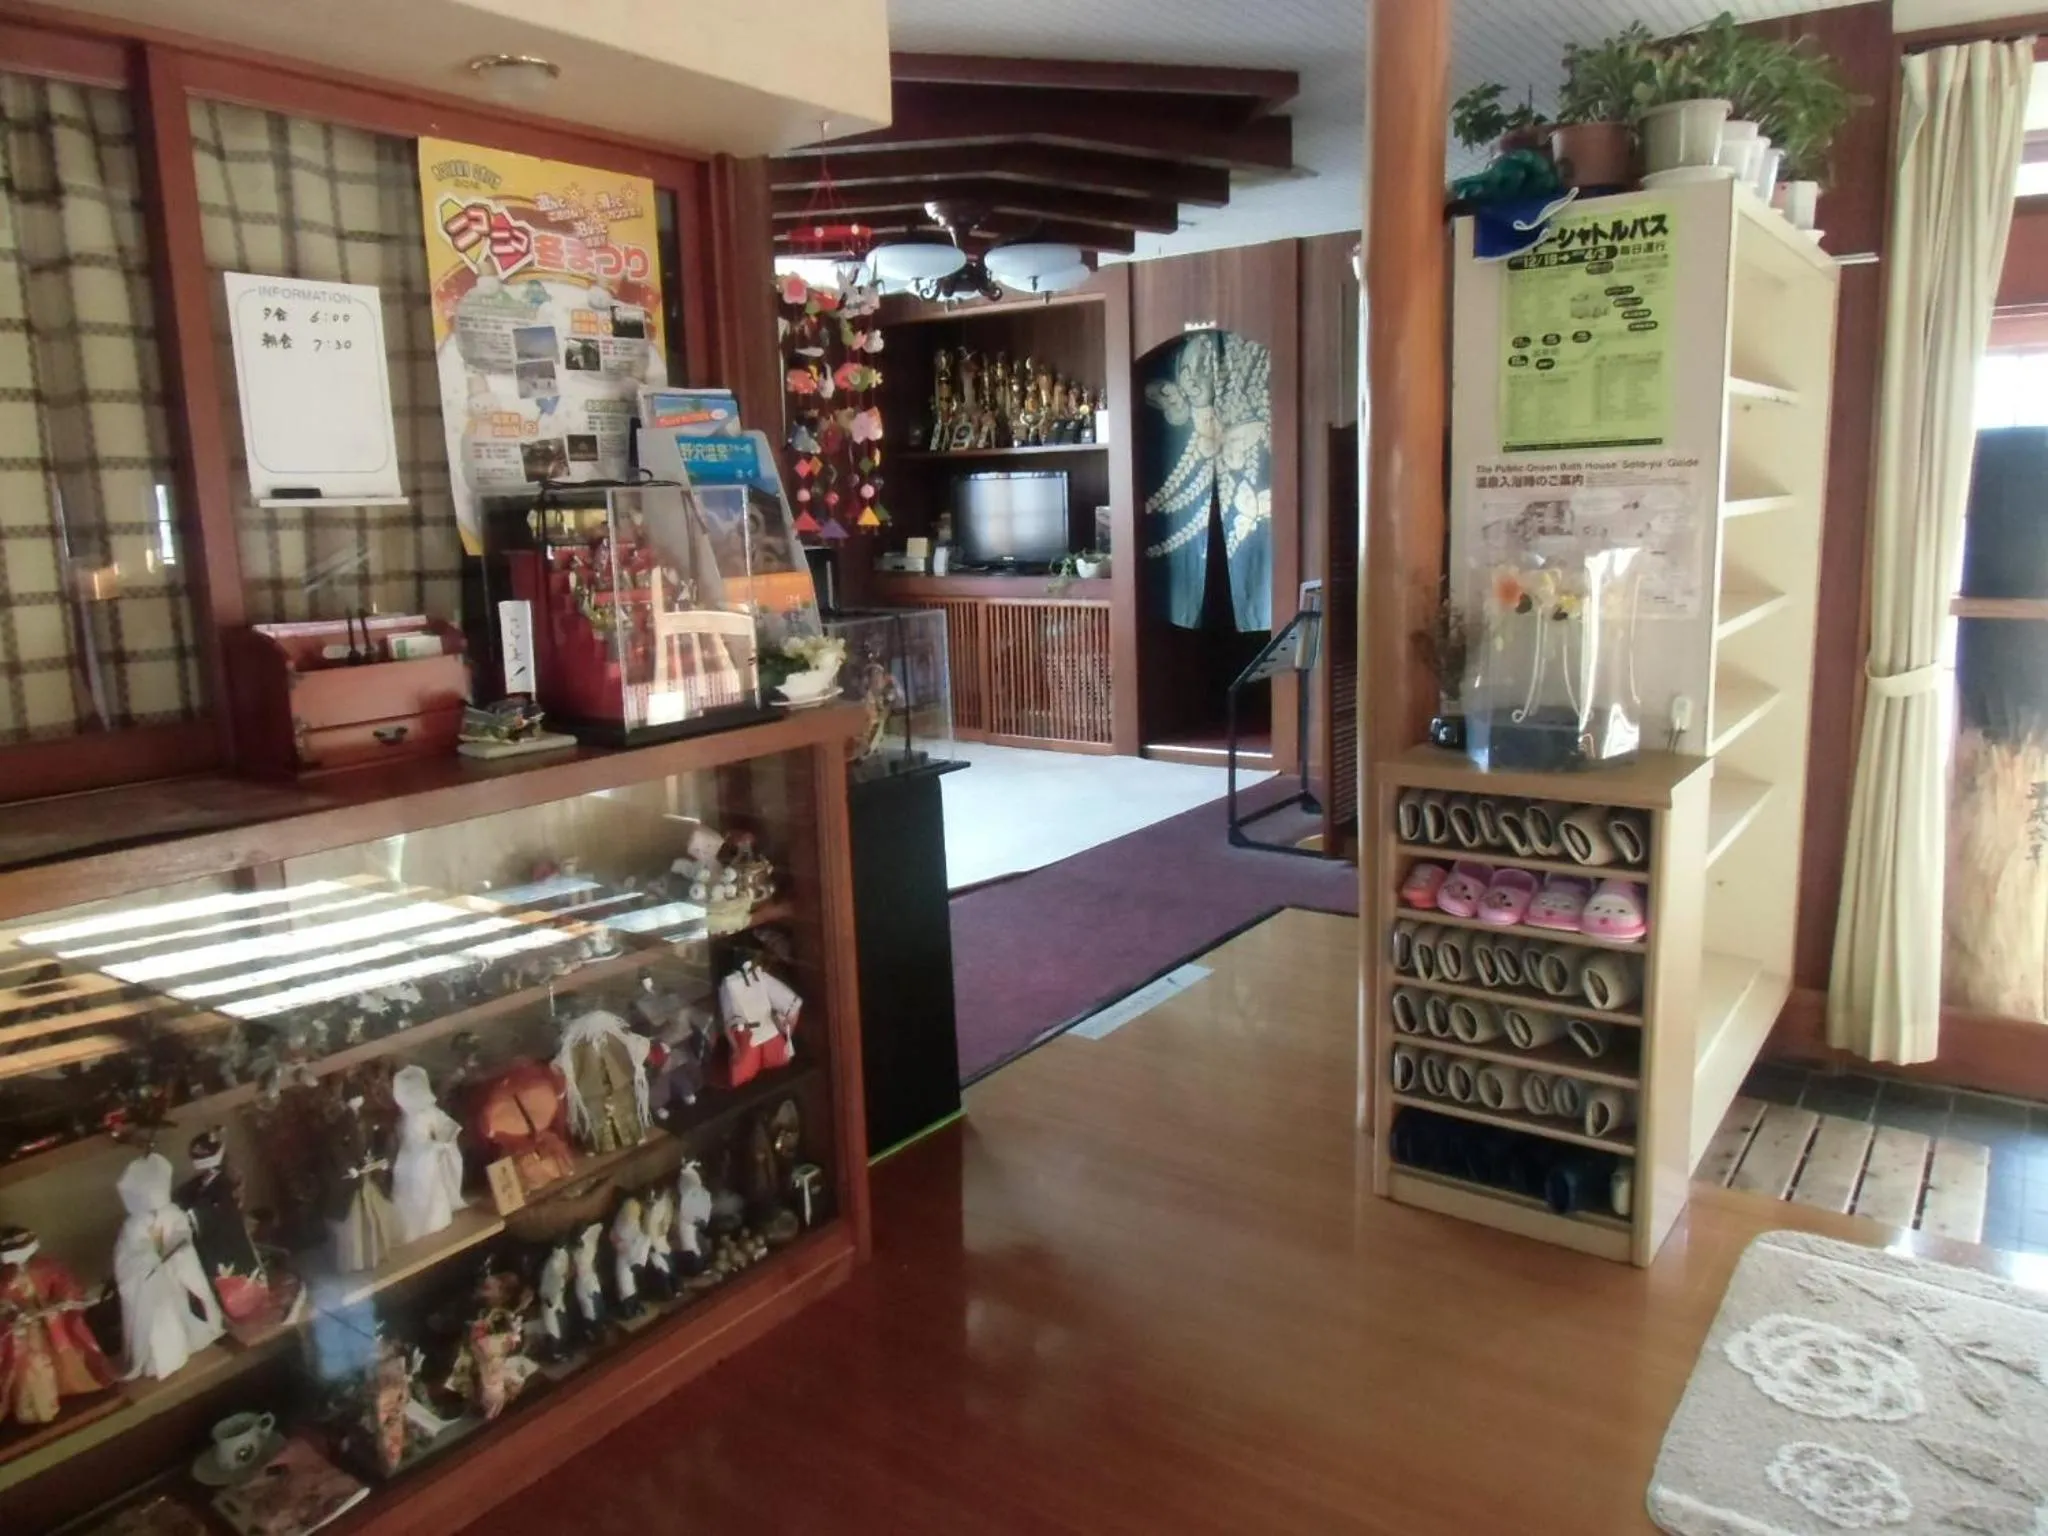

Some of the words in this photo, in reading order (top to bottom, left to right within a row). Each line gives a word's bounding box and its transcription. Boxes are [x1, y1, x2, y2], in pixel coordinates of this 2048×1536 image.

[1532, 214, 1669, 253] ーシャトルバス
[1584, 247, 1607, 259] 4/3
[257, 285, 352, 305] INFORMATION
[262, 307, 288, 322] 夕食
[309, 310, 351, 323] 6:00
[313, 339, 352, 353] 7:30
[1475, 464, 1493, 474] The
[1495, 464, 1522, 474] Public
[1527, 463, 1557, 473] Onsen
[1560, 462, 1582, 472] Bath
[1584, 460, 1617, 470] House
[1667, 458, 1699, 468] Guide
